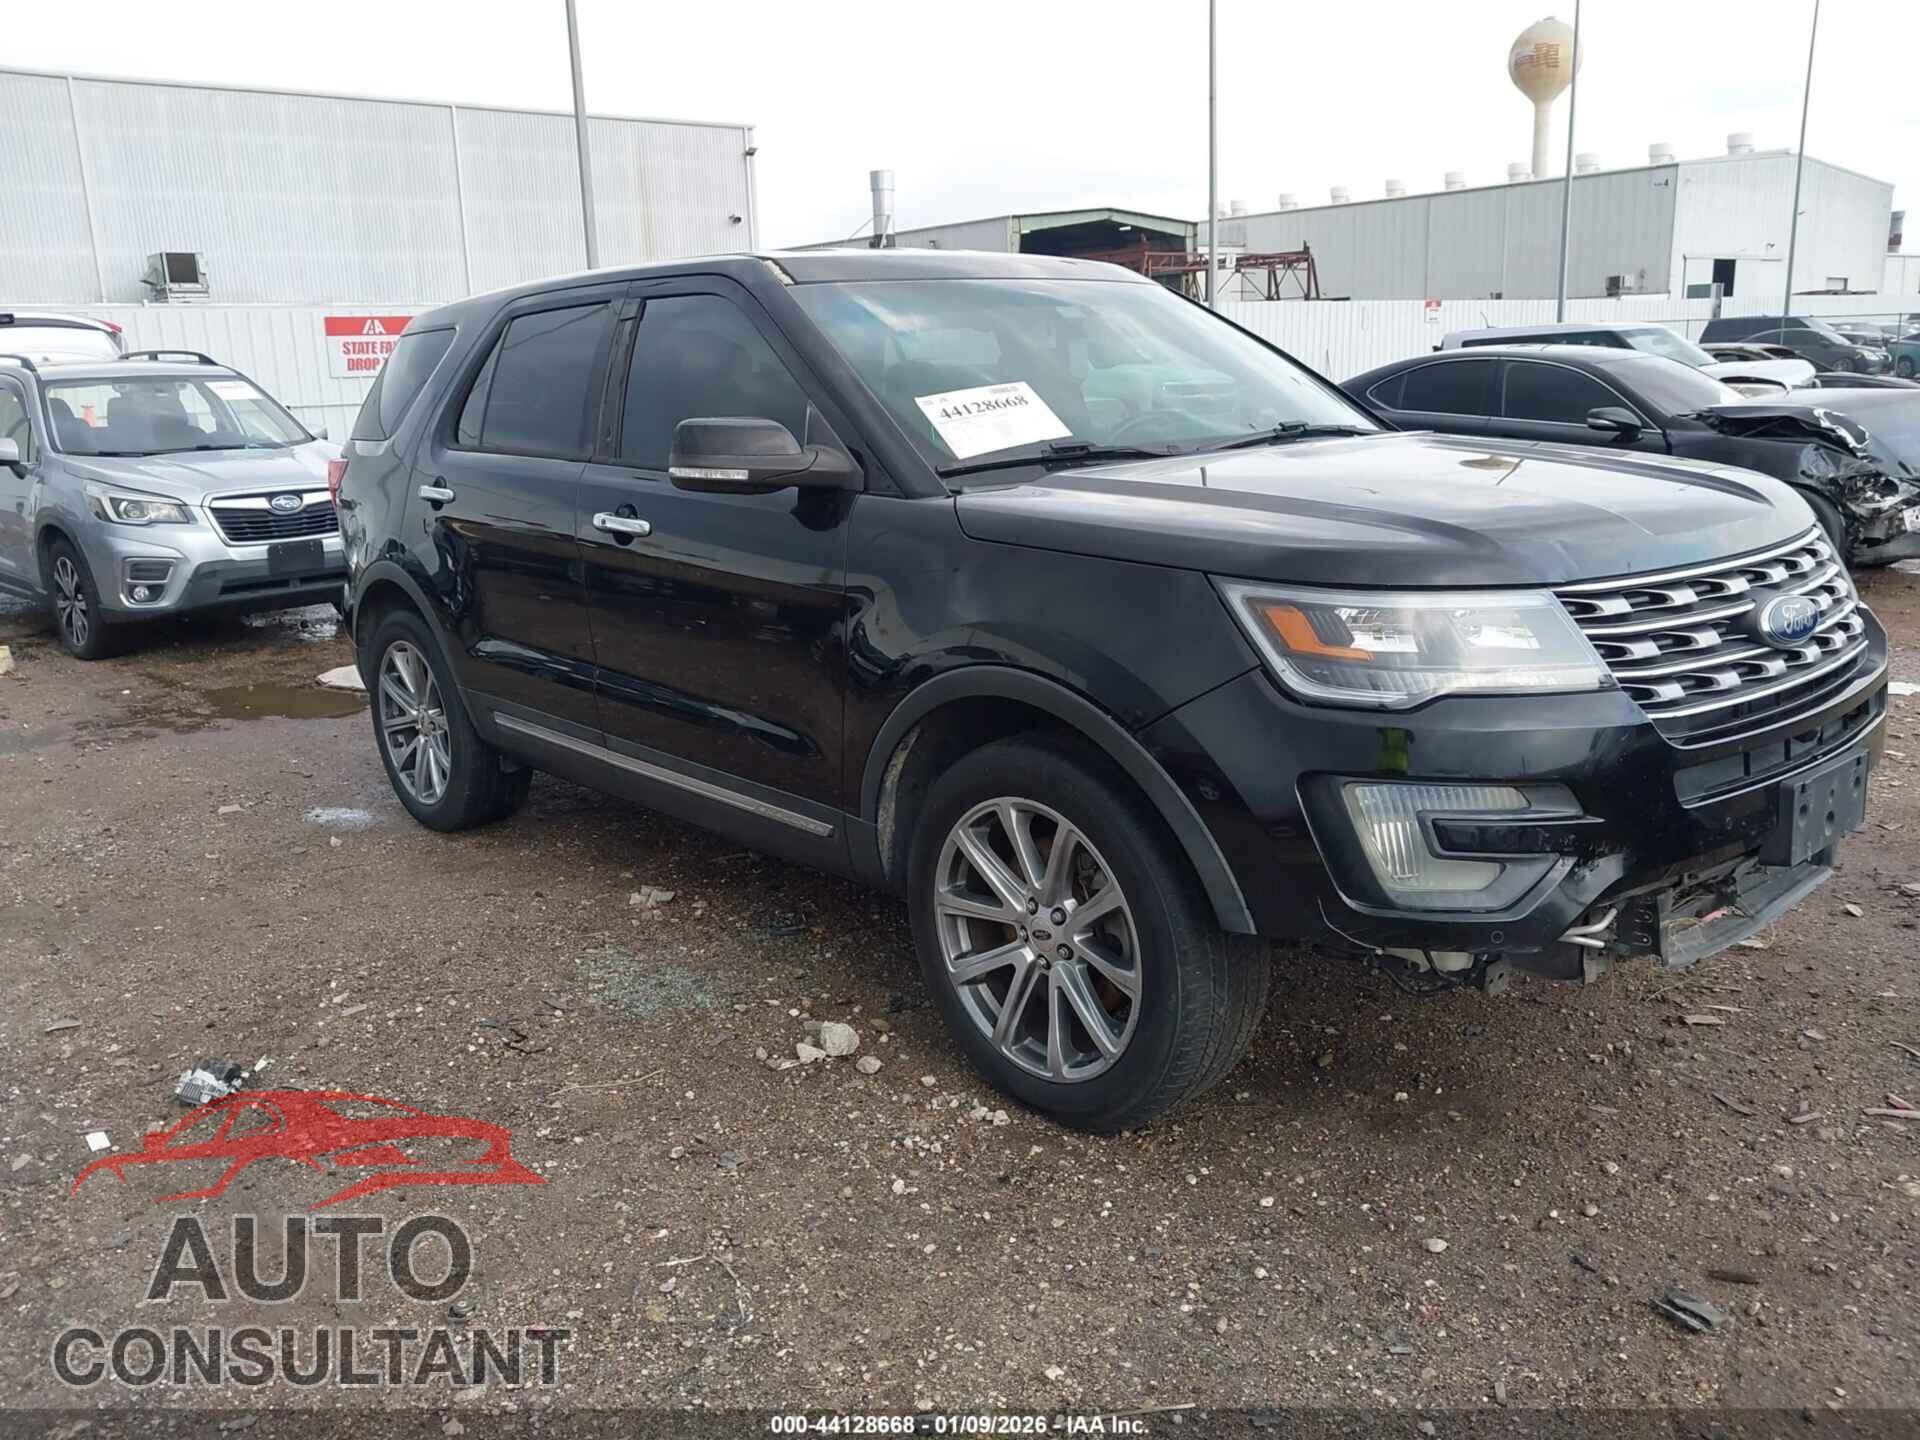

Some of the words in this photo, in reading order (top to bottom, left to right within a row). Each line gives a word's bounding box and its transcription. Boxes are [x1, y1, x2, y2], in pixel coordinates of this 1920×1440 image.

[343, 341, 378, 355] STATE
[347, 358, 380, 371] DROP
[940, 395, 1029, 419] 44128668
[1782, 605, 1815, 634] Ford
